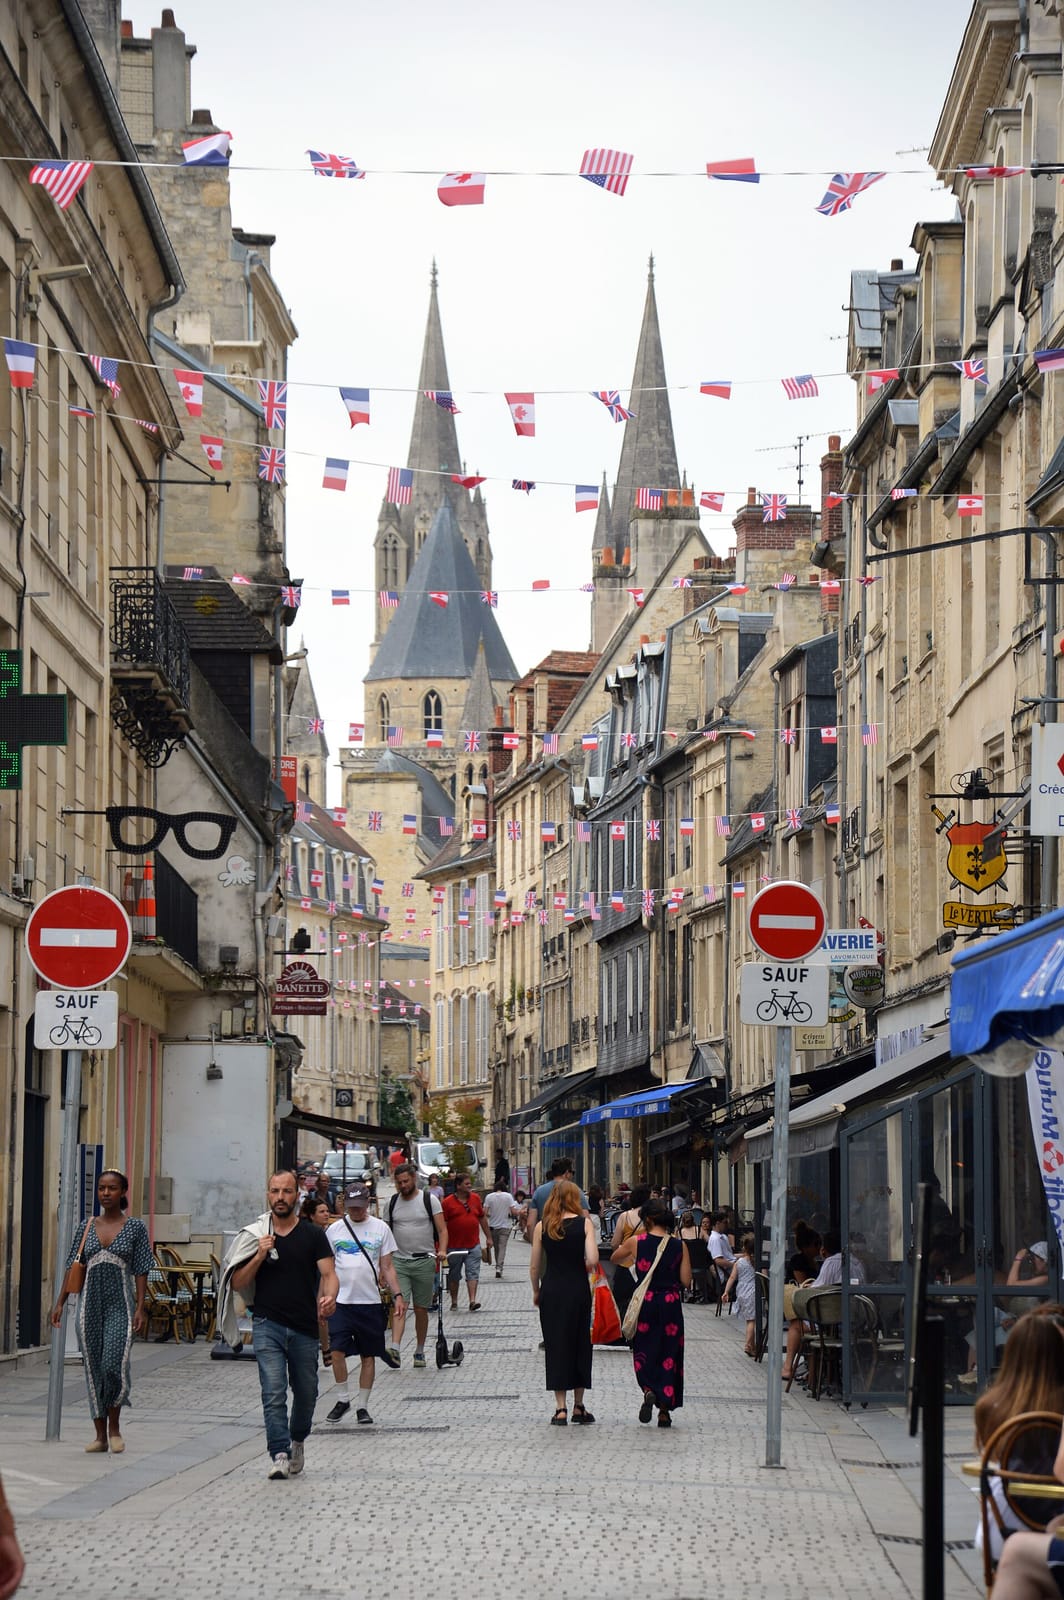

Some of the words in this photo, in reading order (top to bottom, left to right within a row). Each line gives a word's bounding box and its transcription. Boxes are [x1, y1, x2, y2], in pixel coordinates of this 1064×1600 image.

[820, 934, 874, 950] AVERIE
[762, 967, 809, 982] SAUF
[276, 983, 325, 992] BANETTE
[55, 994, 99, 1009] SAUF
